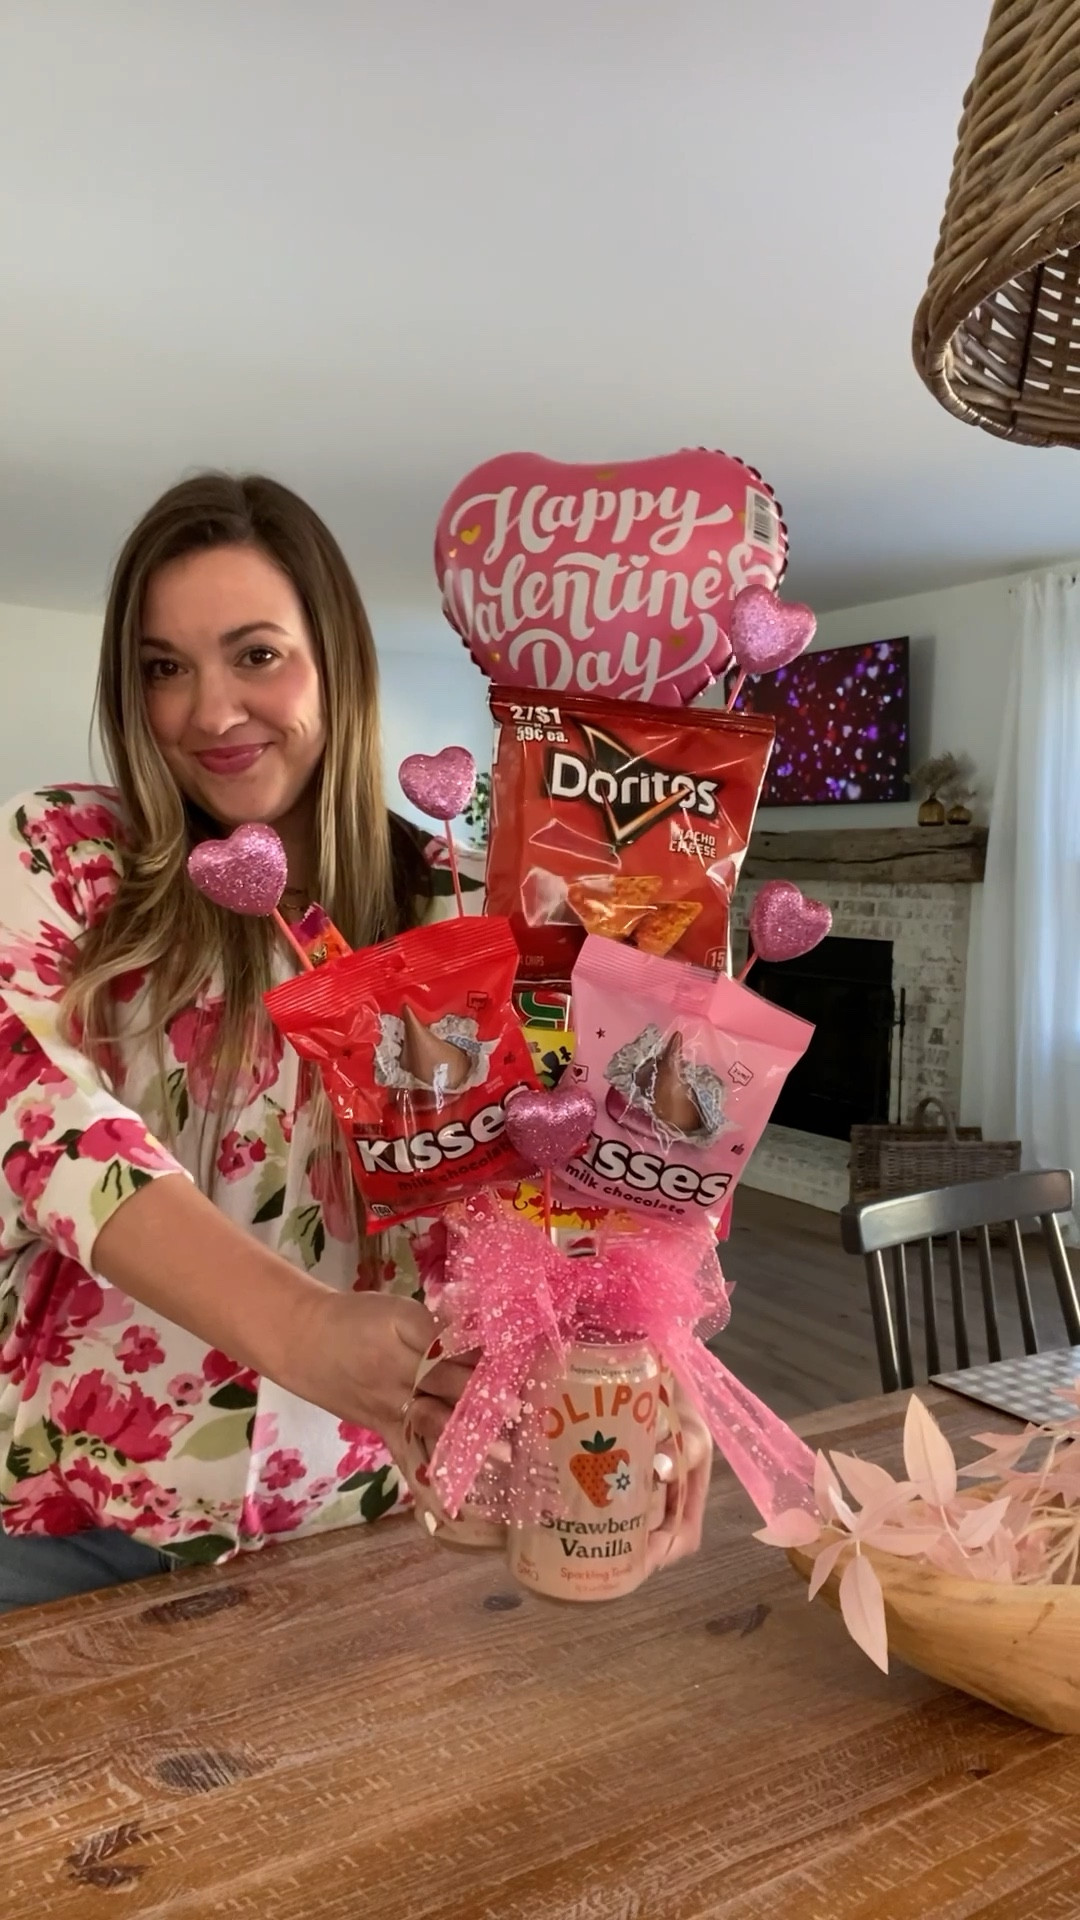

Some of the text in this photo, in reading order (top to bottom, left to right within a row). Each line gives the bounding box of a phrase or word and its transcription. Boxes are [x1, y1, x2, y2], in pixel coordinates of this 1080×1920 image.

[450, 485, 732, 565] Happy
[508, 613, 718, 702] Day
[551, 752, 718, 815] Doritos
[566, 1165, 686, 1216] milk chocolate
[560, 1537, 633, 1559] Vanilla
